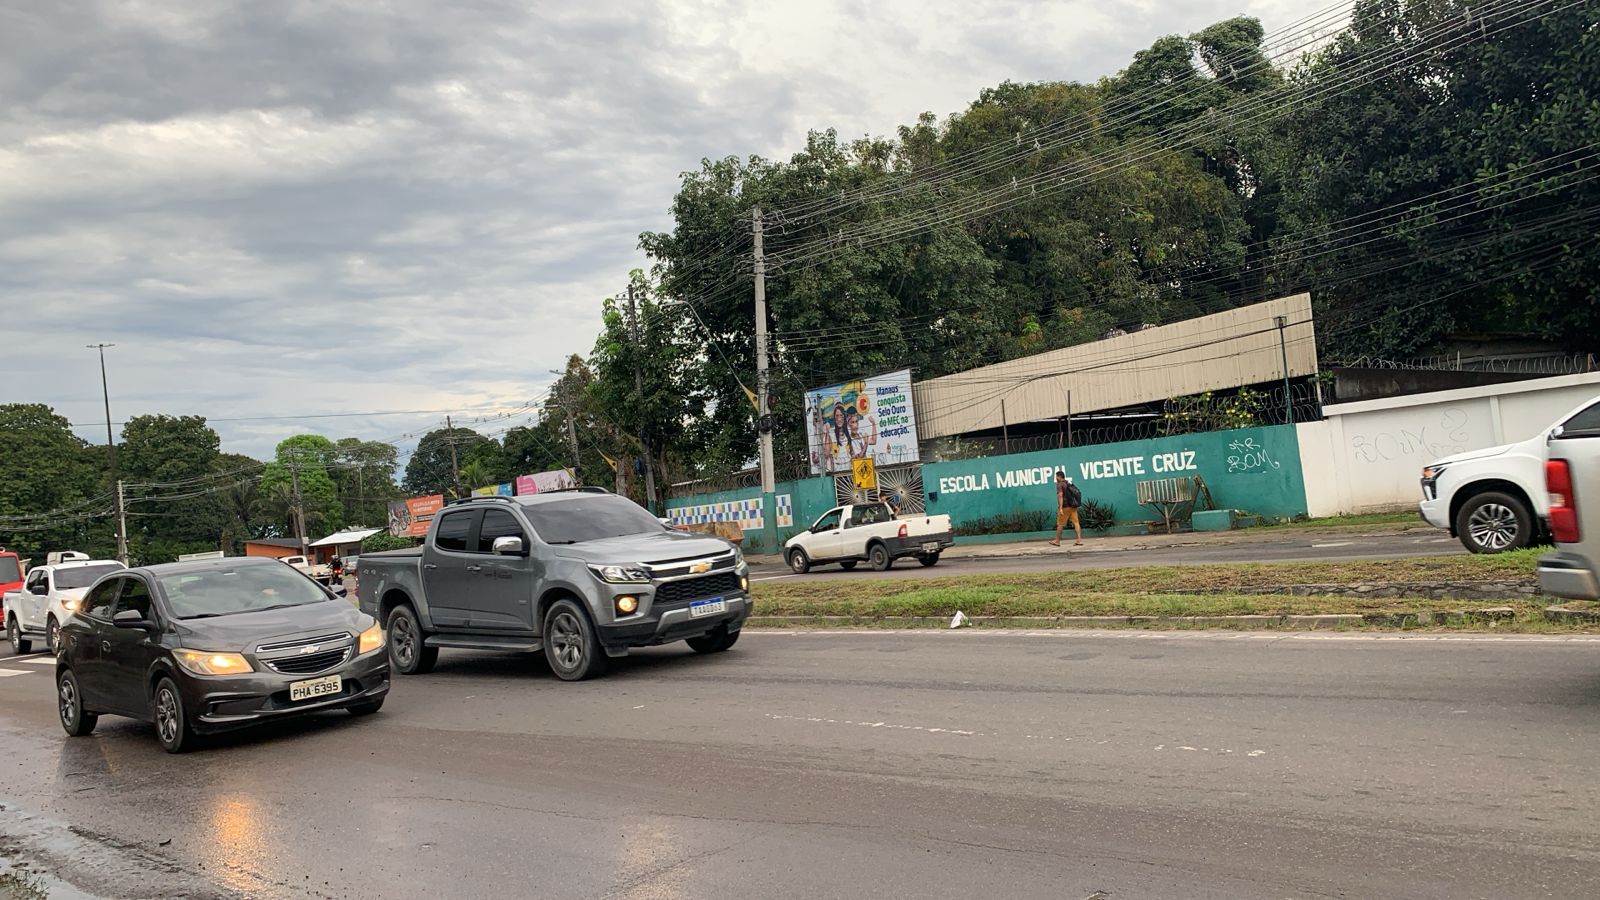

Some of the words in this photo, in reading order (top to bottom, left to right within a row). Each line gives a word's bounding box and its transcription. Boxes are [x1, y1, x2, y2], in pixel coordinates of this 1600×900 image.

[876, 386, 899, 395] Manaus
[877, 394, 906, 407] conquista
[878, 407, 890, 417] Selo
[891, 405, 906, 415] Ouro
[879, 418, 887, 427] do
[887, 416, 900, 426] MEC
[901, 416, 909, 424] na
[880, 425, 910, 438] educação.
[940, 473, 990, 494] ESCOLA
[996, 465, 1073, 489] MUNICIPAL
[1080, 456, 1145, 480] VICENTE
[1152, 451, 1197, 473] CRUZ
